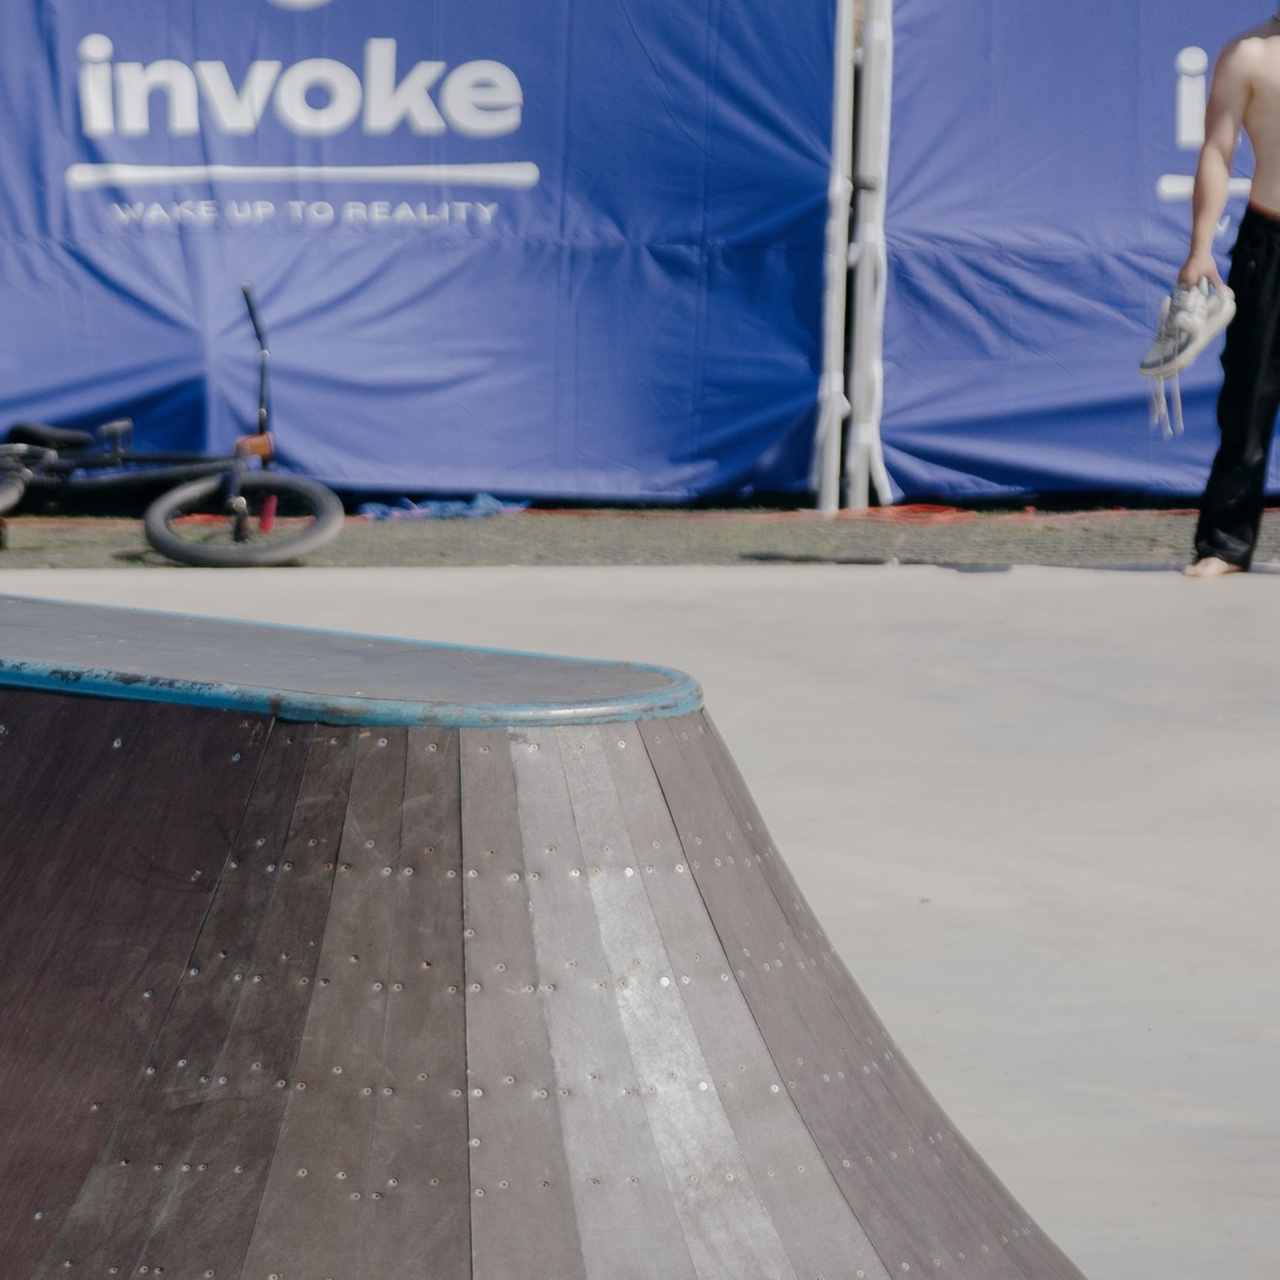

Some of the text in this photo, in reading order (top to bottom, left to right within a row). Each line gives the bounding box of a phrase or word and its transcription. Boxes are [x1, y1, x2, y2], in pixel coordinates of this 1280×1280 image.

[77, 34, 524, 138] invoke
[110, 200, 500, 228] WAKE UP TO REALITY
